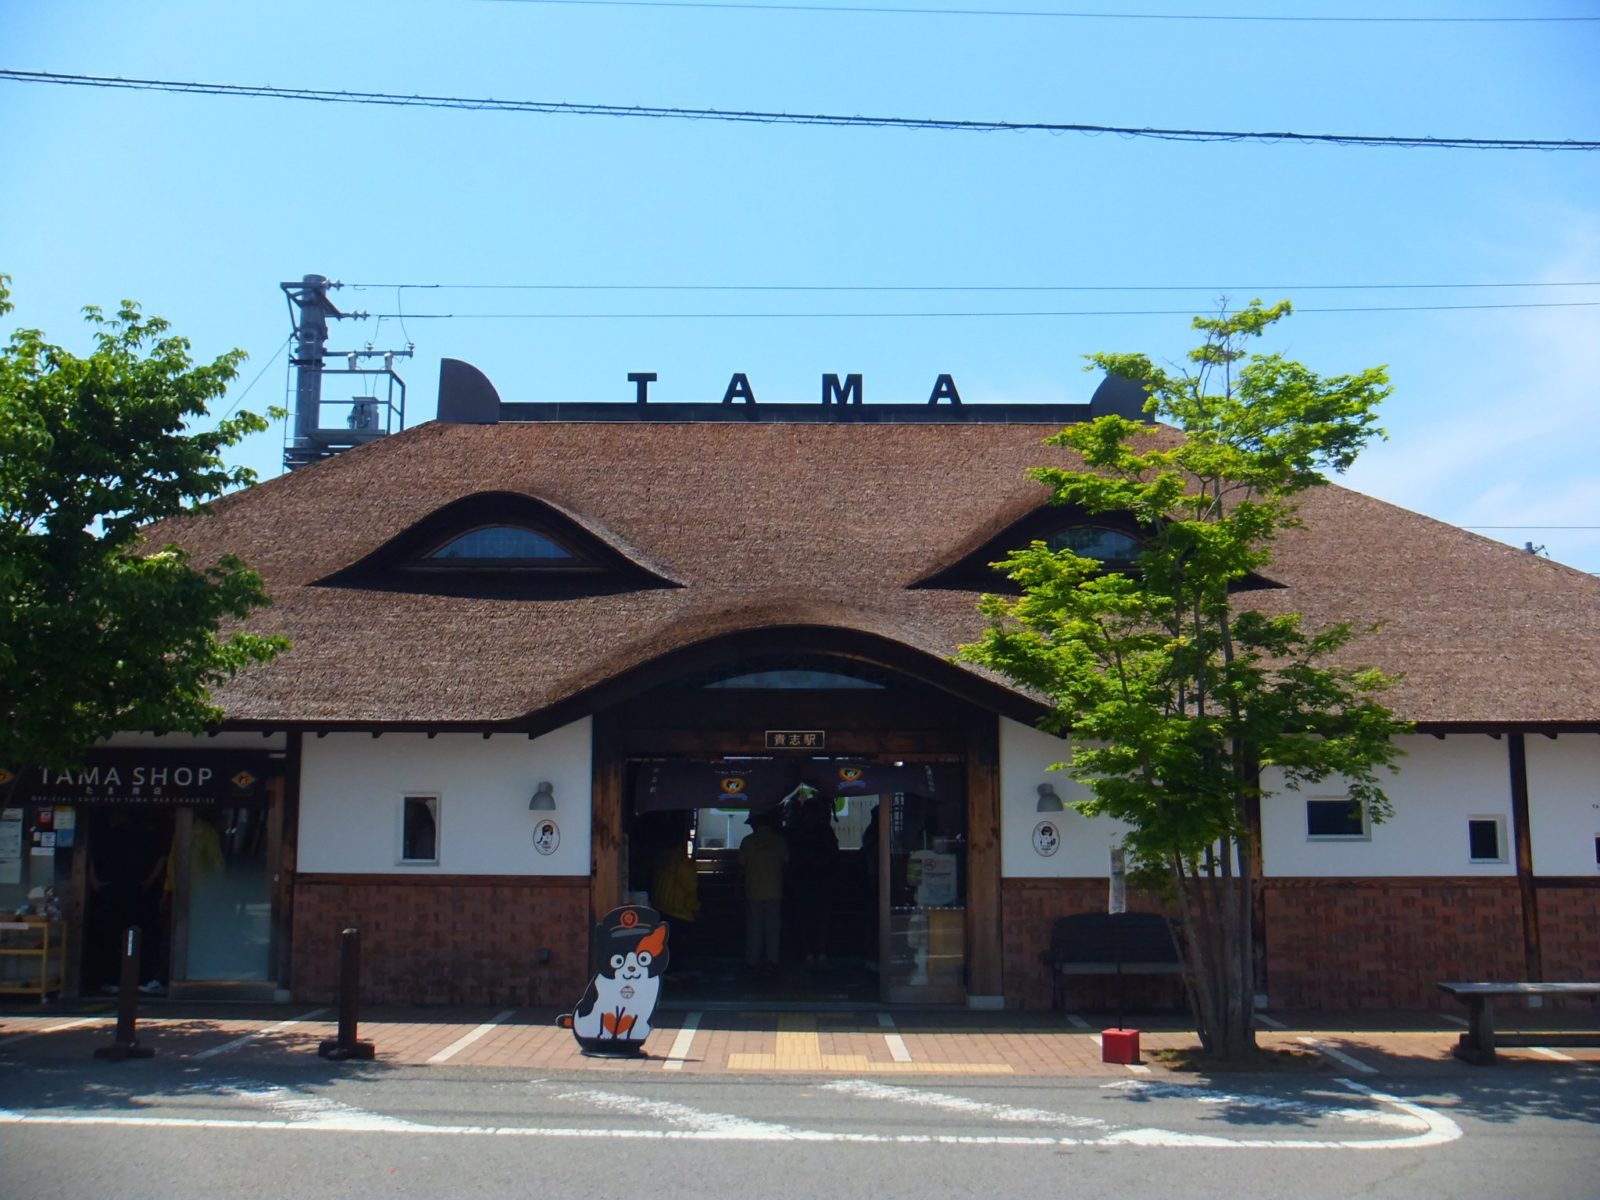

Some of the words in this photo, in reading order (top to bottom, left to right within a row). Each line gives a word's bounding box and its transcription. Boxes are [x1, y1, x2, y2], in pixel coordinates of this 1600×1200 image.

[627, 373, 963, 405] TAMA
[774, 733, 817, 746] 貴志駅
[39, 766, 121, 785] TAMA
[132, 766, 213, 786] SHOP
